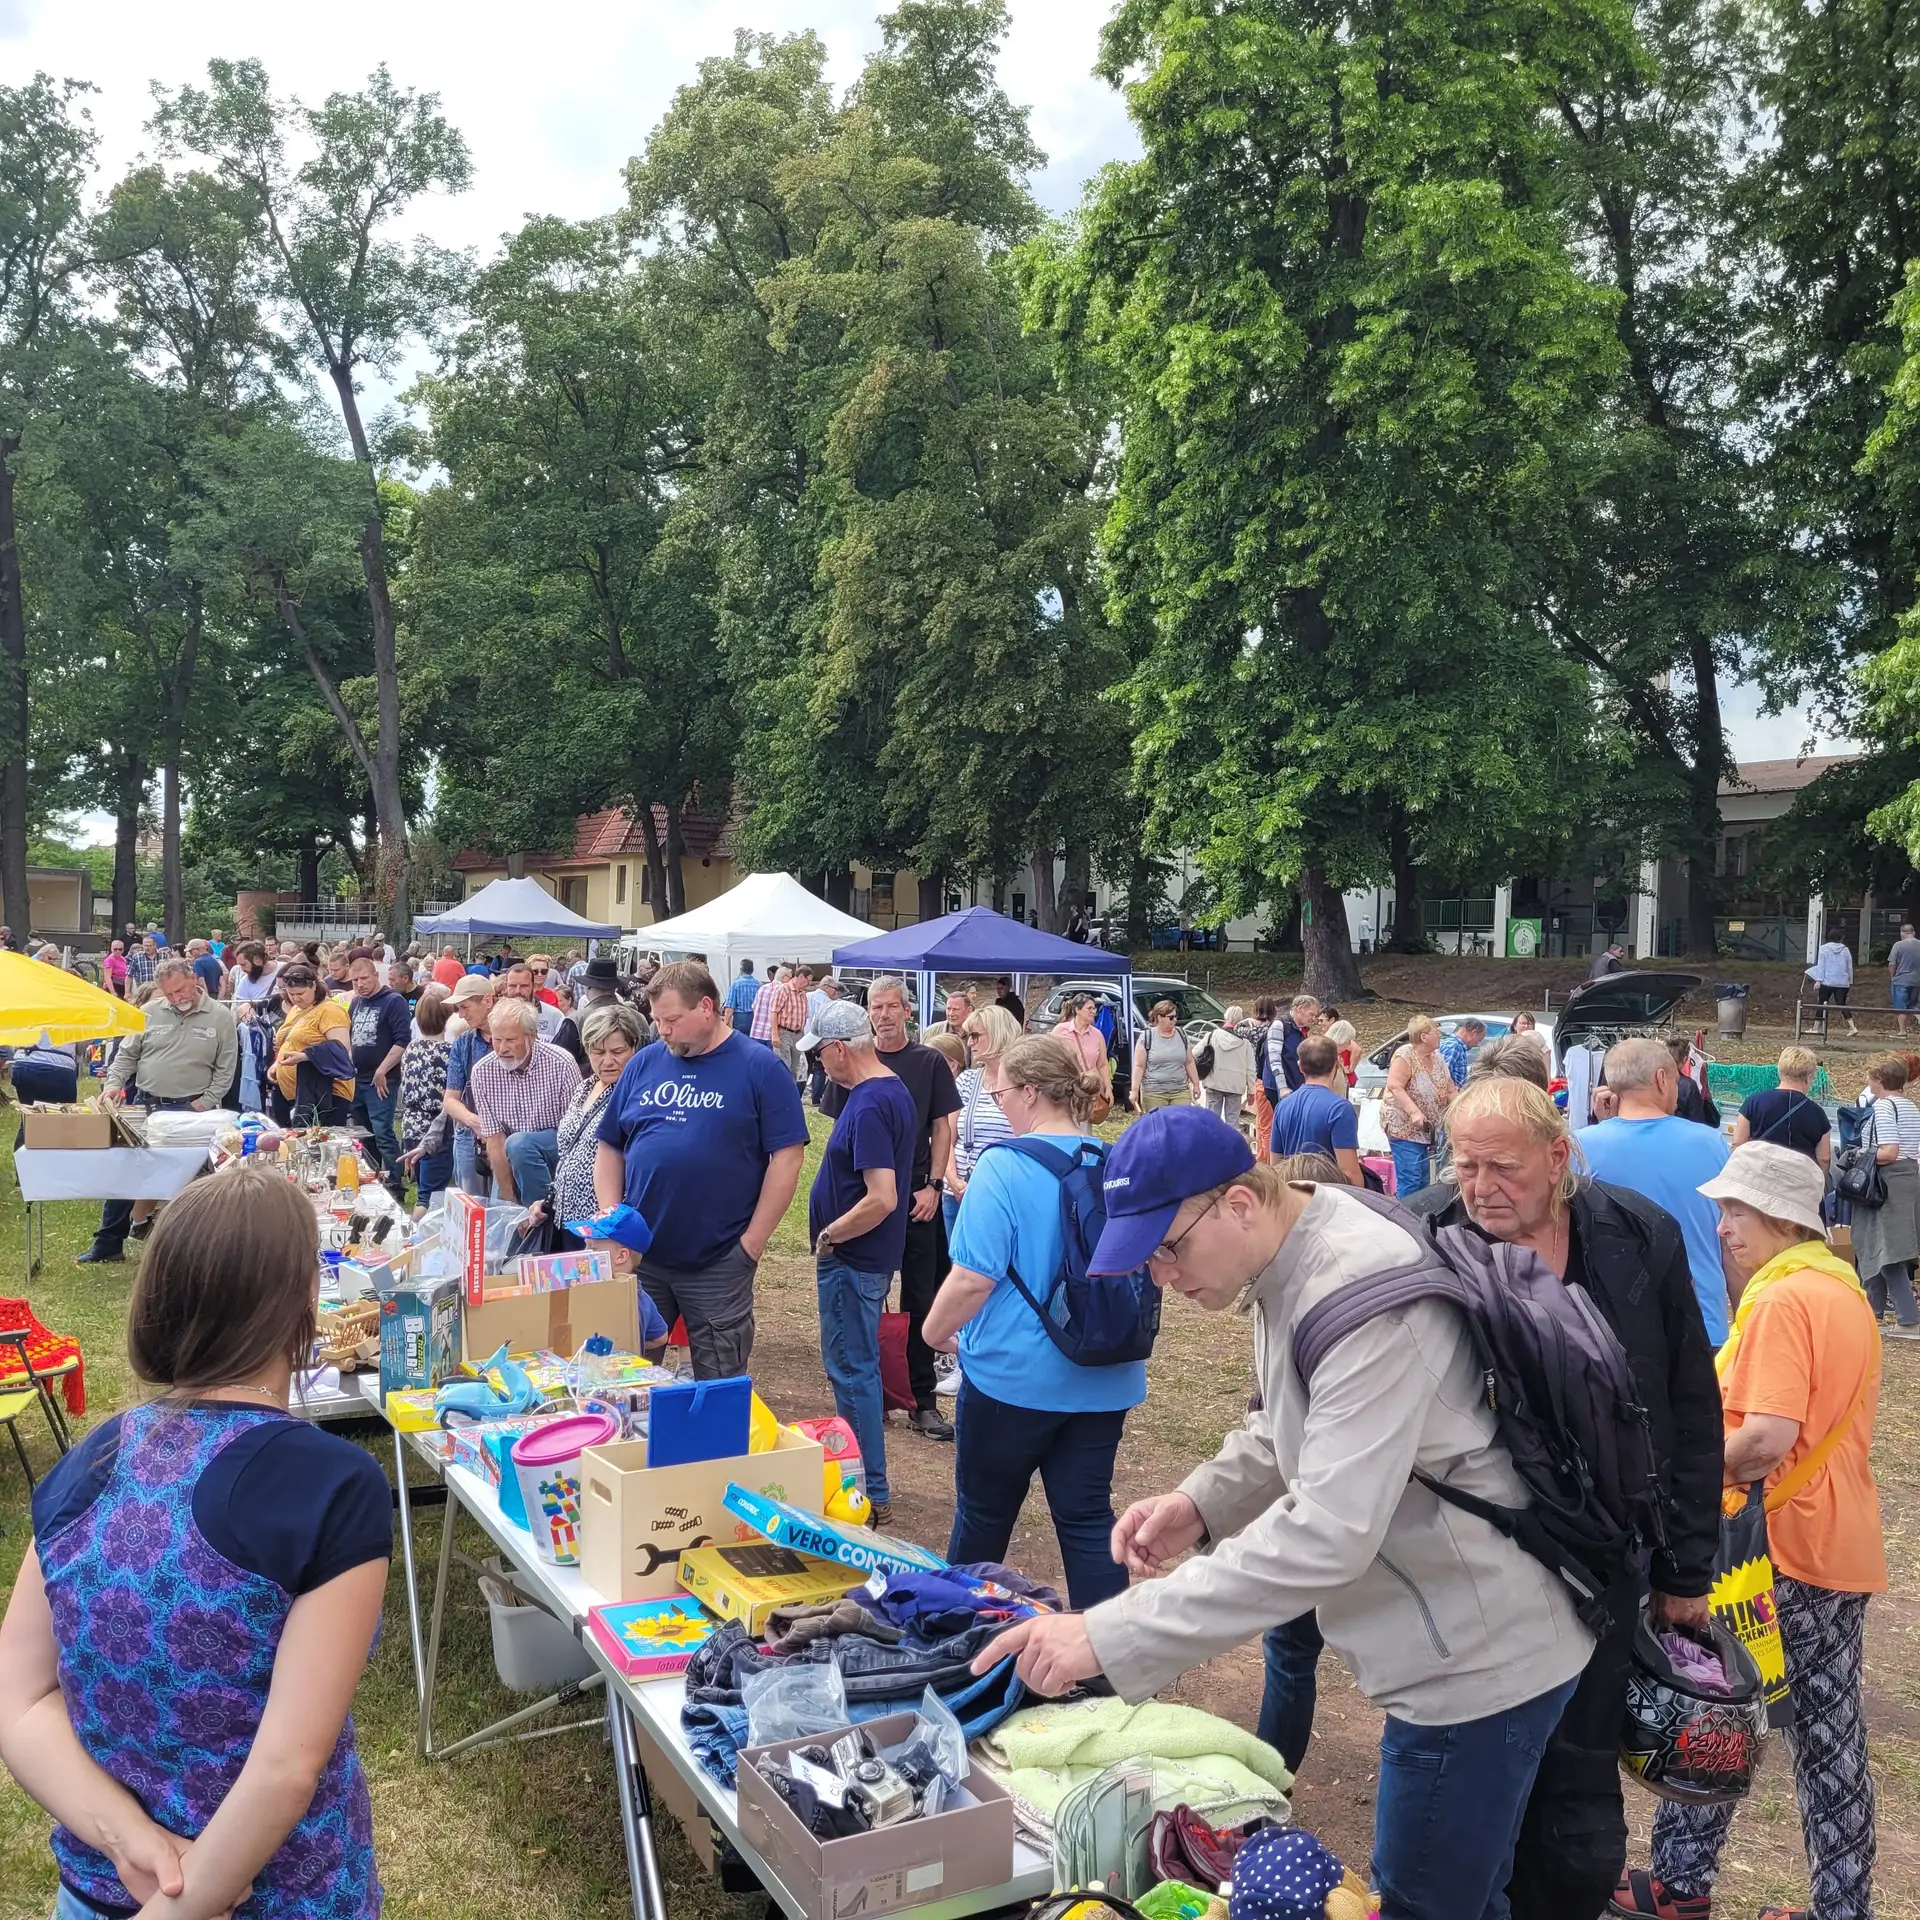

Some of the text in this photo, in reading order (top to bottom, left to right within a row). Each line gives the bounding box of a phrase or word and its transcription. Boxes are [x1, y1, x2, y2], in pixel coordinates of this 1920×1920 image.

[640, 1081, 724, 1108] s.Oliver
[474, 1220, 482, 1261] Magnetic
[788, 1526, 838, 1556] VERO
[1734, 1627, 1768, 1645] CKEN!
[656, 1660, 675, 1671] loto
